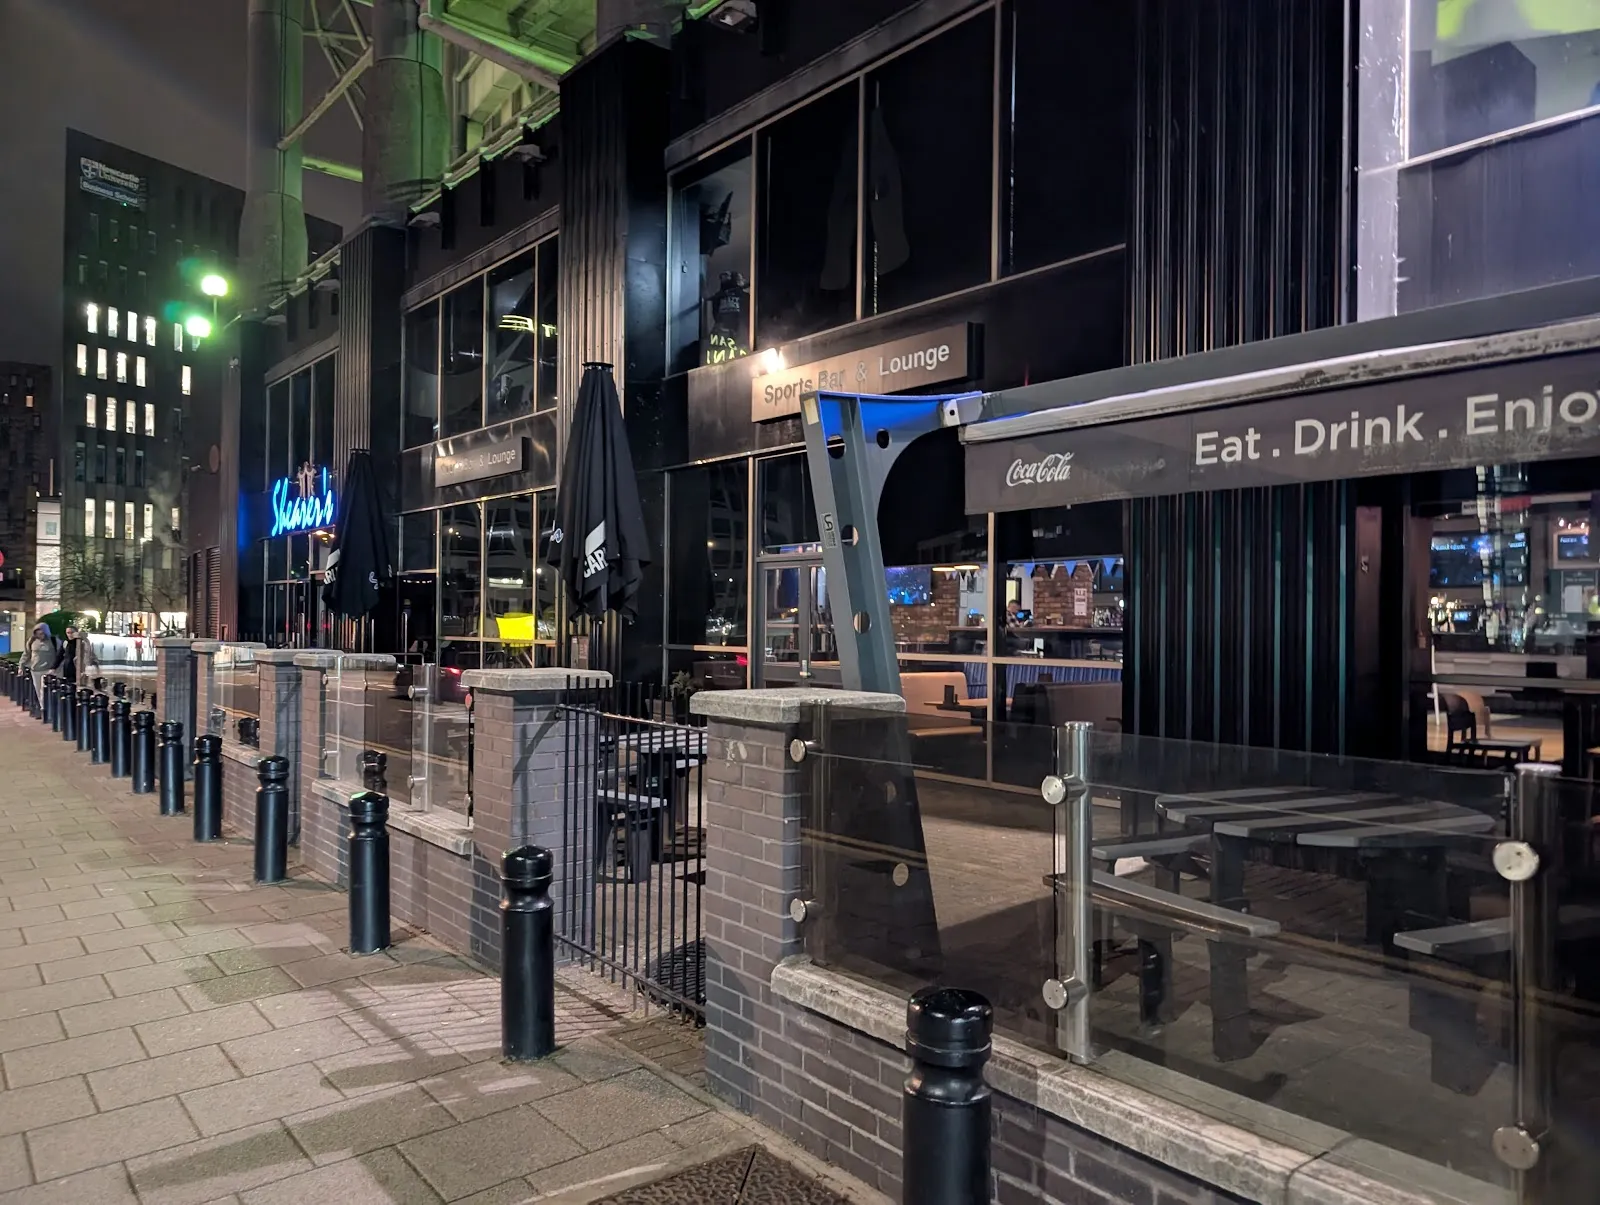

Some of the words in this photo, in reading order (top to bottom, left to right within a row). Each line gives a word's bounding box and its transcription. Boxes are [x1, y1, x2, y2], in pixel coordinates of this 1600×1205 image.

[764, 377, 813, 405] Sports
[818, 369, 845, 391] Bar
[855, 361, 868, 382] &
[879, 344, 950, 375] Lounge
[1466, 384, 1600, 436] Enjo
[487, 449, 516, 465] Lounge
[1006, 452, 1074, 487] Coca-Cola
[271, 466, 334, 537] Shearer's
